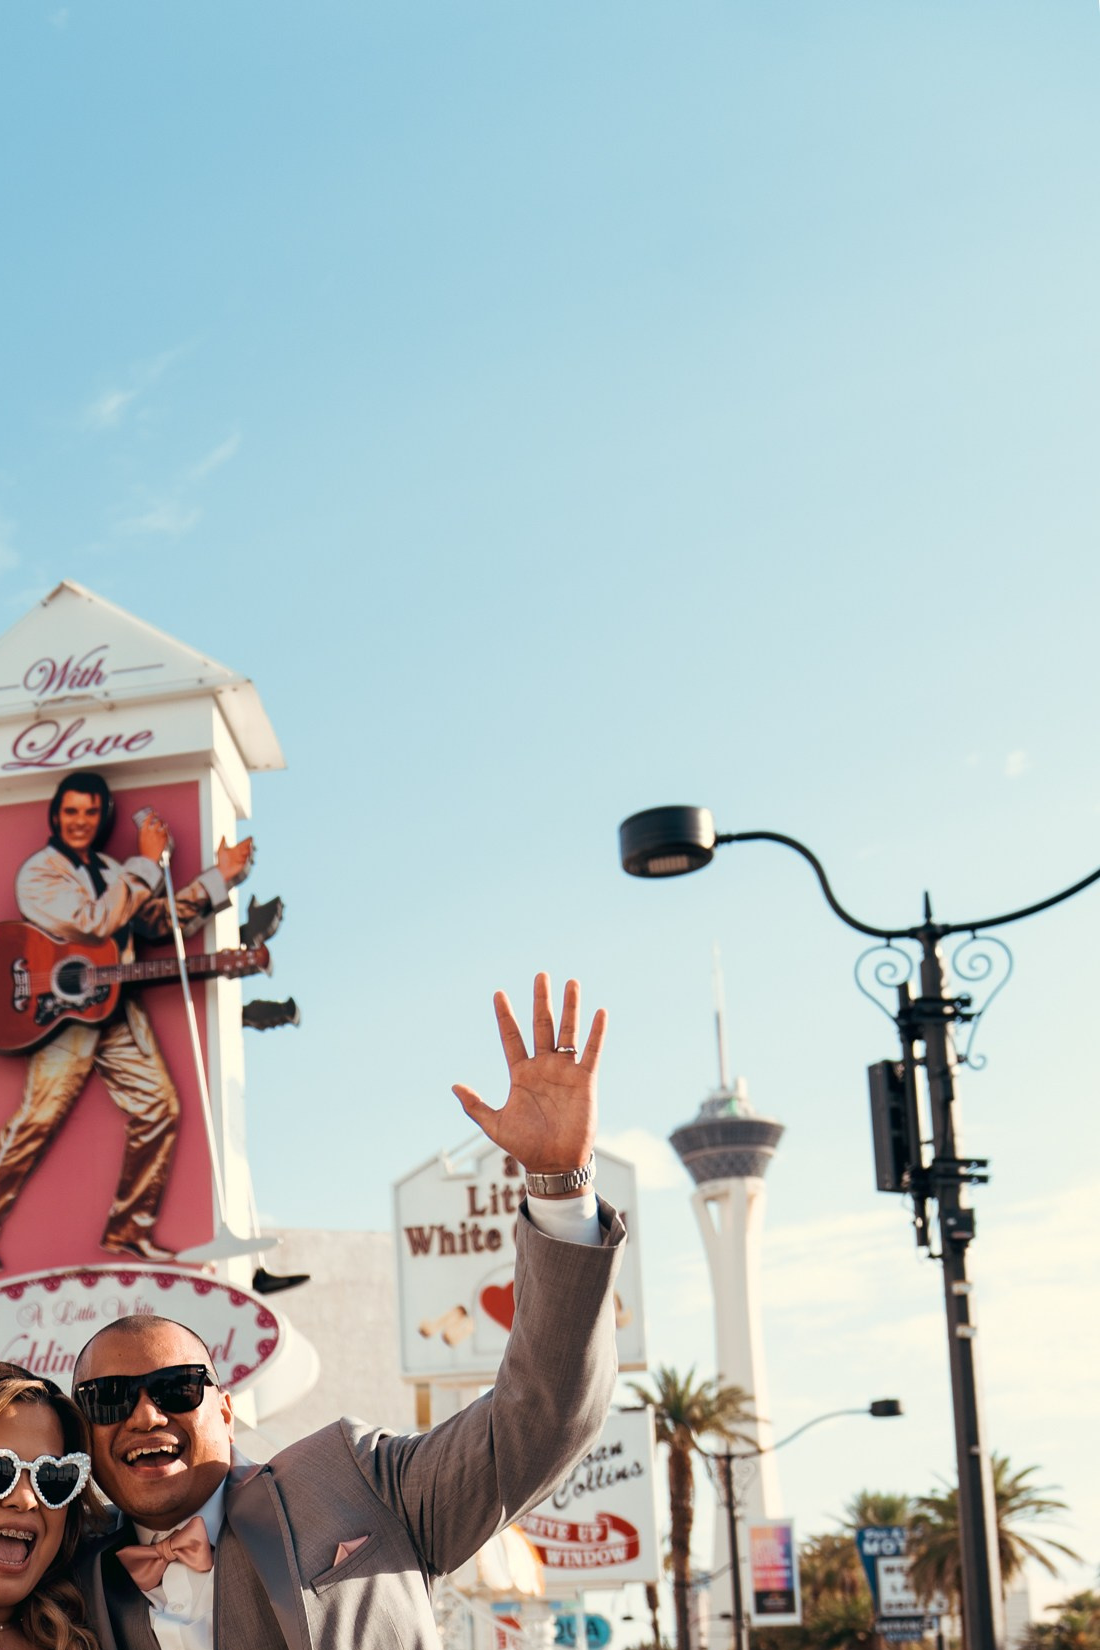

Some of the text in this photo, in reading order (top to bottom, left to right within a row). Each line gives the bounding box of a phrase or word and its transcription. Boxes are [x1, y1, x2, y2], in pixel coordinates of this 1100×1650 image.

[23, 645, 109, 696] With
[1, 718, 154, 770] Love
[503, 1155, 520, 1177] a
[467, 1183, 527, 1217] Litt
[404, 1221, 502, 1257] White
[52, 1299, 97, 1326] Little
[553, 1461, 644, 1510] Collins
[578, 1525, 604, 1540] UP
[546, 1547, 628, 1566] WINDOW
